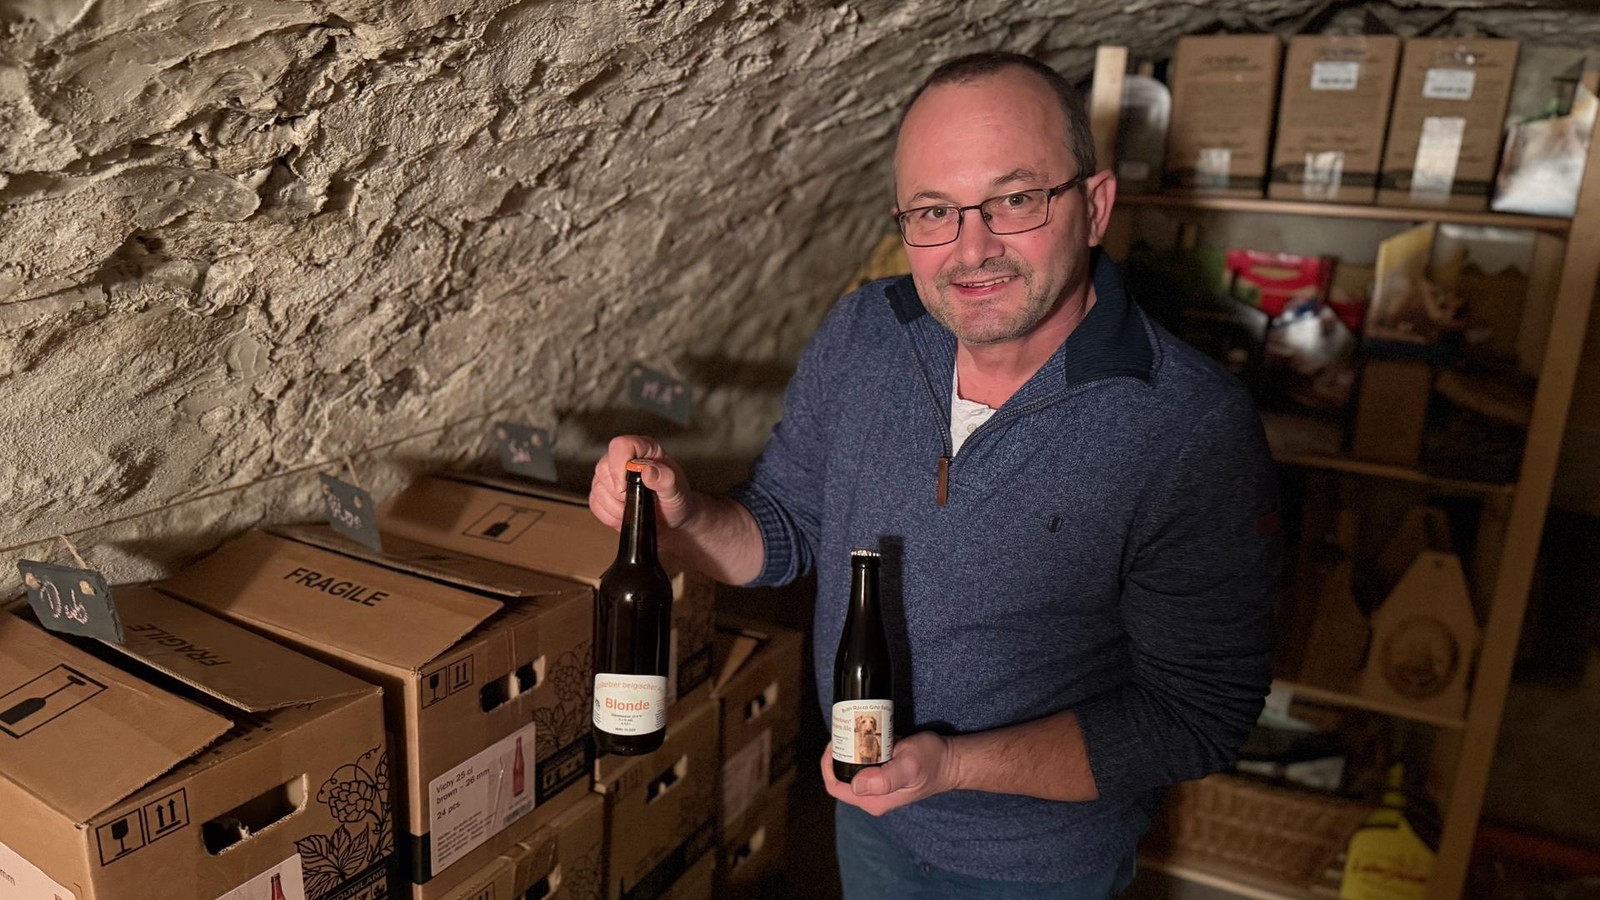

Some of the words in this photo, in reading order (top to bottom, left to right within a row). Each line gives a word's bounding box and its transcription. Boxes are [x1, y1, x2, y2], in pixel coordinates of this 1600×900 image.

[283, 567, 390, 607] FRAGILE
[126, 623, 232, 667] FRAGILE
[605, 697, 650, 711] Blonde
[436, 778, 455, 793] Vichy
[456, 770, 466, 782] 25
[467, 766, 473, 775] cl
[436, 788, 458, 805] brown
[465, 775, 475, 787] 26
[476, 768, 490, 780] mm
[437, 808, 447, 820] 24
[448, 801, 461, 814] pcs
